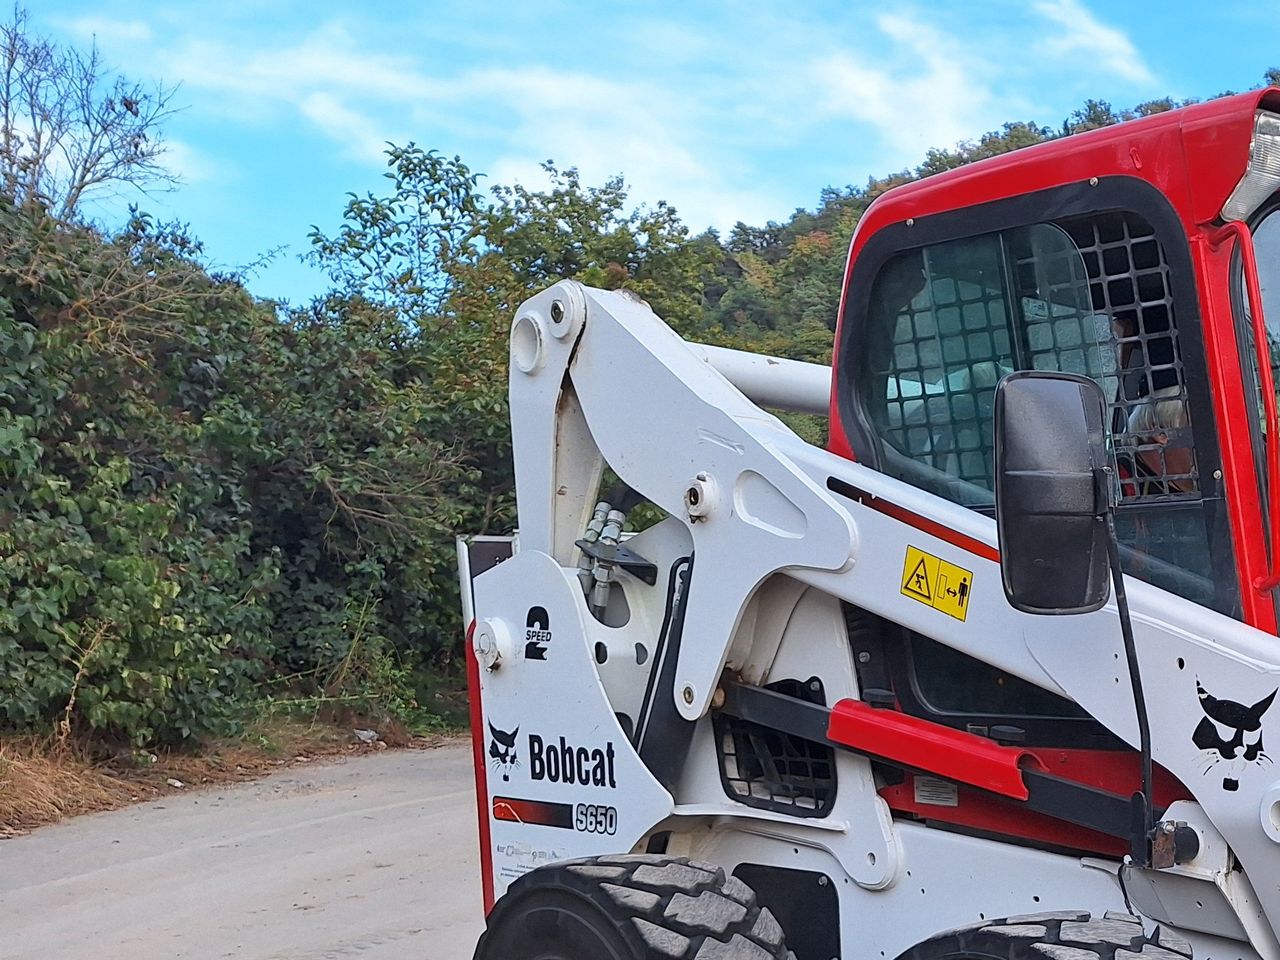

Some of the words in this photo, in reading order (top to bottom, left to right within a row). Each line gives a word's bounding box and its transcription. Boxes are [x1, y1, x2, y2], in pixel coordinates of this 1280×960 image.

[525, 629, 552, 642] SPEED
[528, 733, 617, 789] Bobcat
[575, 802, 618, 836] S650
